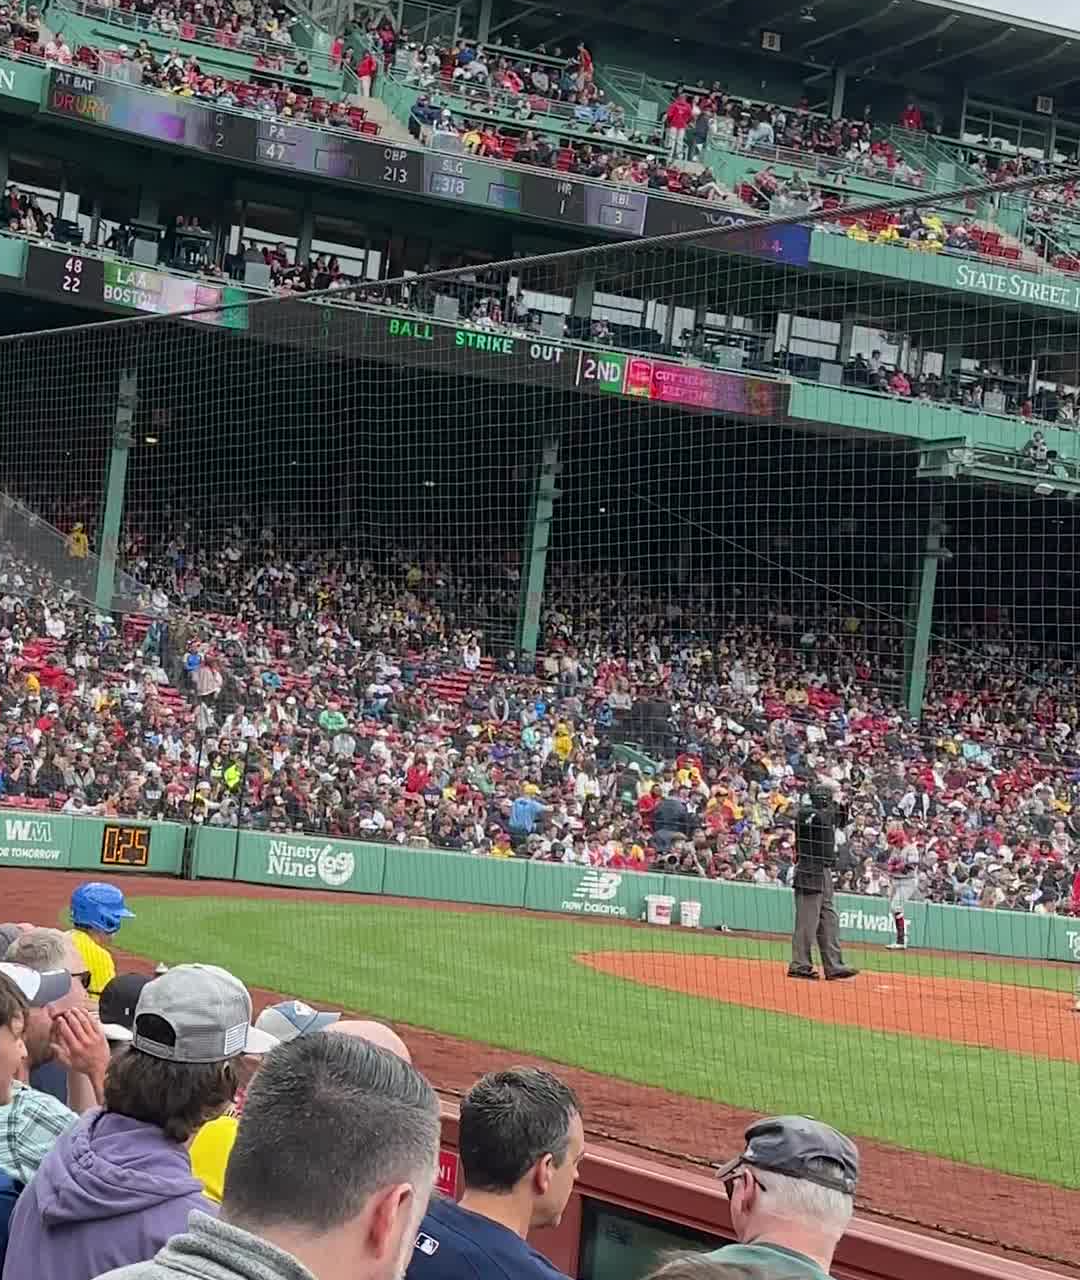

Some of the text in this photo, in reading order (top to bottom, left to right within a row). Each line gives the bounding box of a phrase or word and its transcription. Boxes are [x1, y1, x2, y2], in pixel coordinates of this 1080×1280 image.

[56, 70, 95, 93] AT BAT
[265, 144, 285, 160] 47
[64, 257, 82, 273] 48
[63, 276, 80, 293] 22
[956, 264, 1008, 294] STATE
[389, 319, 620, 382] BALL STRIKE OUT 2ND
[5, 820, 52, 841] WM
[11, 847, 61, 860] TOMORROW
[268, 840, 321, 862] Ninety
[266, 856, 317, 877] Nine
[561, 900, 583, 911] new
